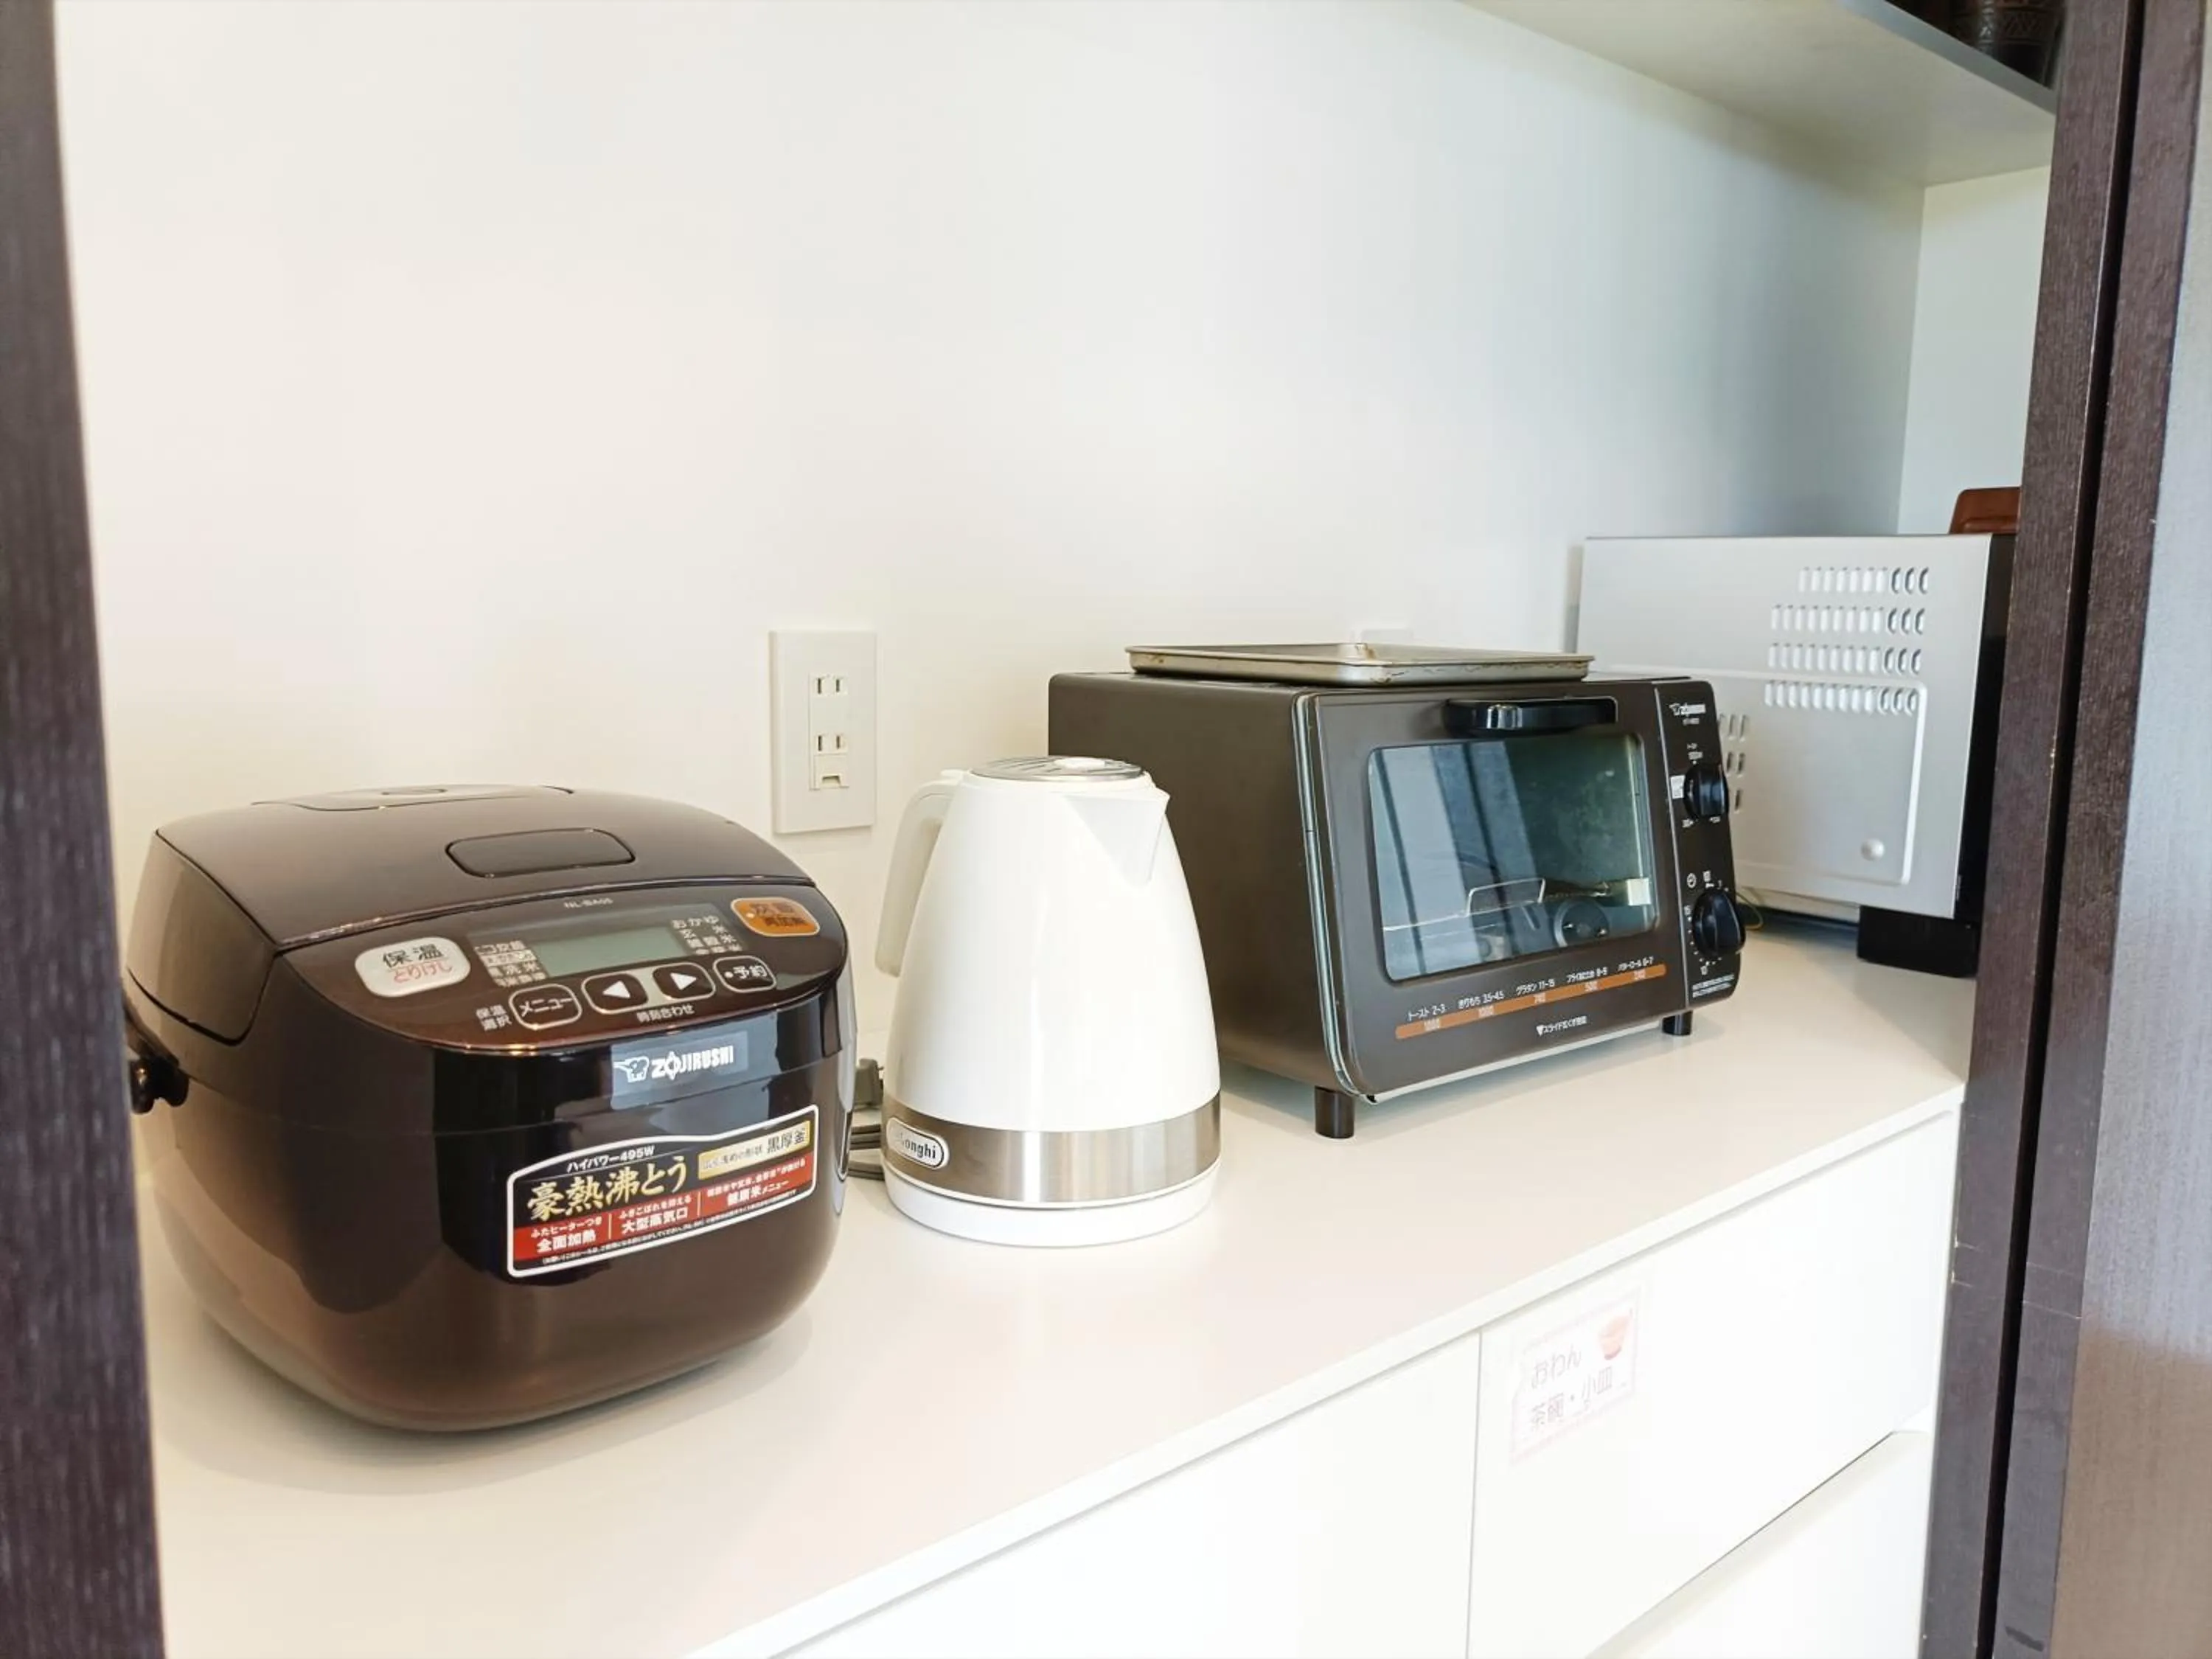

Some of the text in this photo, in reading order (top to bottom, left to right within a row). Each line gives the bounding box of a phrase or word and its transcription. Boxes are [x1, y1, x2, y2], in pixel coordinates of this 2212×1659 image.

[672, 915, 719, 929] おかゆ
[383, 943, 445, 968] 保温
[393, 959, 453, 983] とりけし
[733, 965, 768, 979] 予約
[519, 998, 573, 1018] メニュー
[1408, 1004, 1447, 1021] トースト 2-3
[652, 1046, 734, 1080] ZOJIRUSHI
[566, 1145, 655, 1173] ハイパワー495W
[527, 1155, 687, 1221] 豪熱沸とう
[537, 1229, 597, 1253] 全面加熱
[1531, 1343, 1582, 1389] おわん
